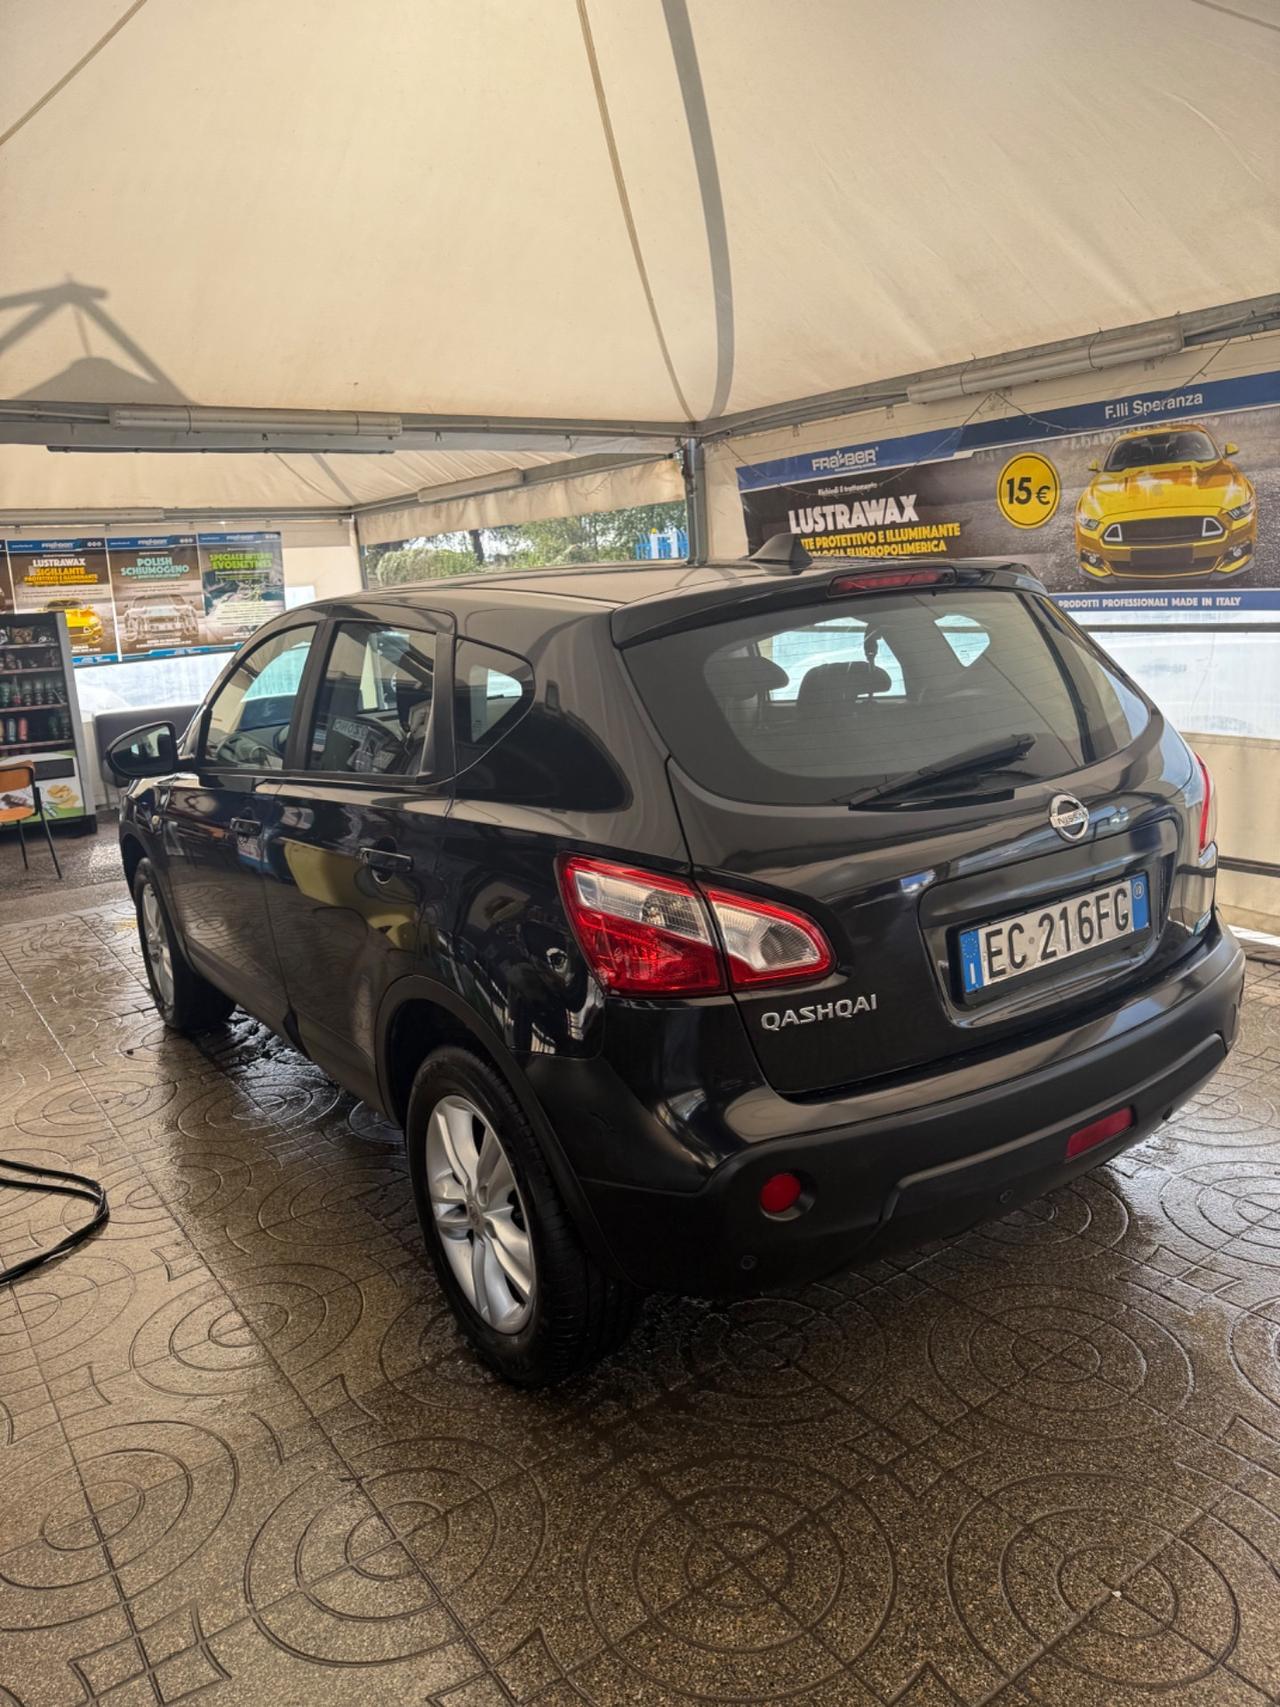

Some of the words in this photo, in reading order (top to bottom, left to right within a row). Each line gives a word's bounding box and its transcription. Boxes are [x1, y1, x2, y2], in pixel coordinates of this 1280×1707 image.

[1132, 393, 1203, 416] Speranza
[1007, 477, 1031, 504] 15
[1036, 485, 1050, 505] €
[788, 494, 919, 534] LUSTRAWAX
[816, 533, 876, 550] PROTETTIVO
[878, 532, 885, 542] E
[886, 522, 961, 541] ILLUMINANTE
[32, 558, 87, 568] LUSTRAWAX
[36, 567, 85, 576] SIGILLANTE
[120, 565, 189, 576] SCHIUMOGENO
[136, 557, 172, 567] POLISH
[1058, 600, 1099, 609] PRODOTTI
[1102, 598, 1168, 607] PROFESSIONALI
[1171, 598, 1198, 606] MADE
[1202, 597, 1212, 606] IN
[1216, 597, 1241, 606] ITALY
[987, 922, 1027, 979] EC
[1040, 888, 1129, 961] 216FG
[761, 994, 878, 1032] QASHQAI
